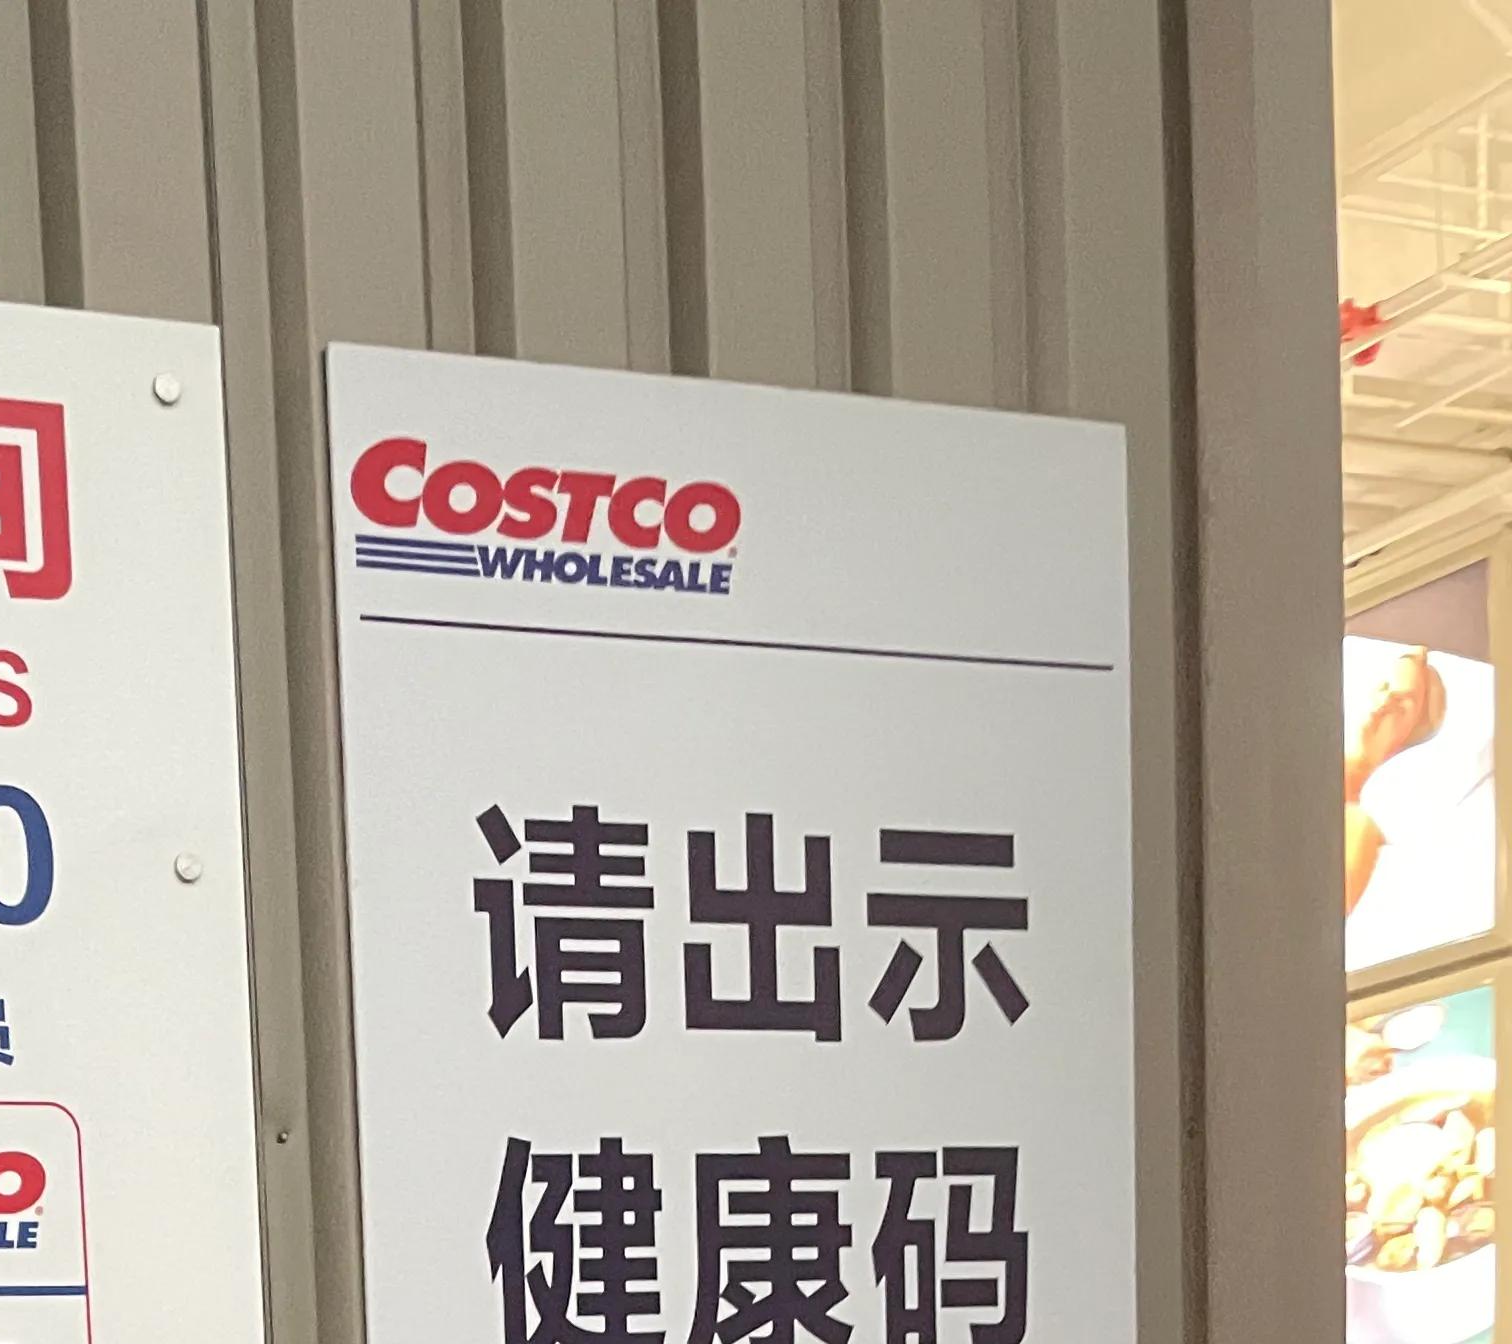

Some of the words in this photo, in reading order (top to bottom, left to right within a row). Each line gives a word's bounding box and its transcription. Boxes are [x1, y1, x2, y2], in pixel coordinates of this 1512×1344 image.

[350, 438, 741, 550] COSTCO
[477, 545, 733, 595] WHOLESALE
[472, 804, 1031, 1043] 请出示
